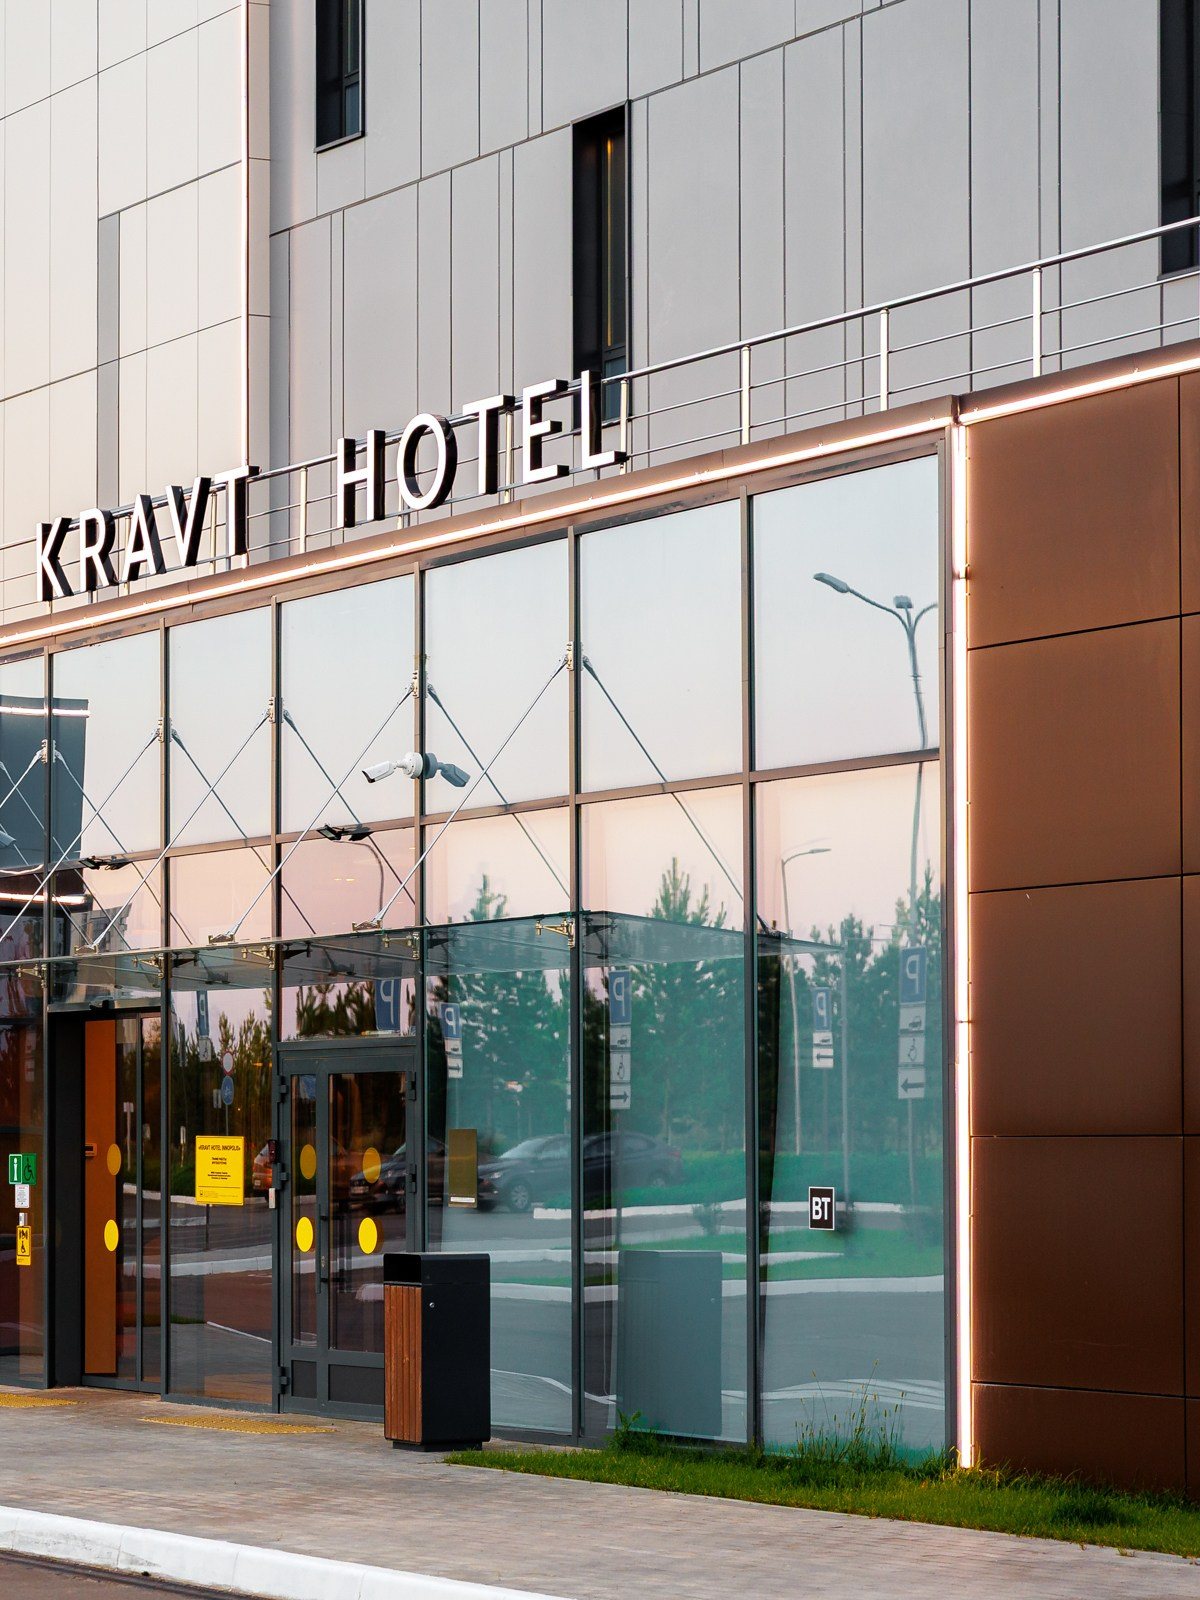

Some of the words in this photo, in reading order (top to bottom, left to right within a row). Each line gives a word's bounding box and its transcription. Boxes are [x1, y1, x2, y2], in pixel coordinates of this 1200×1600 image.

[36, 464, 262, 602] KRAVT
[336, 370, 631, 530] HOTEL
[812, 1196, 831, 1220] BT
